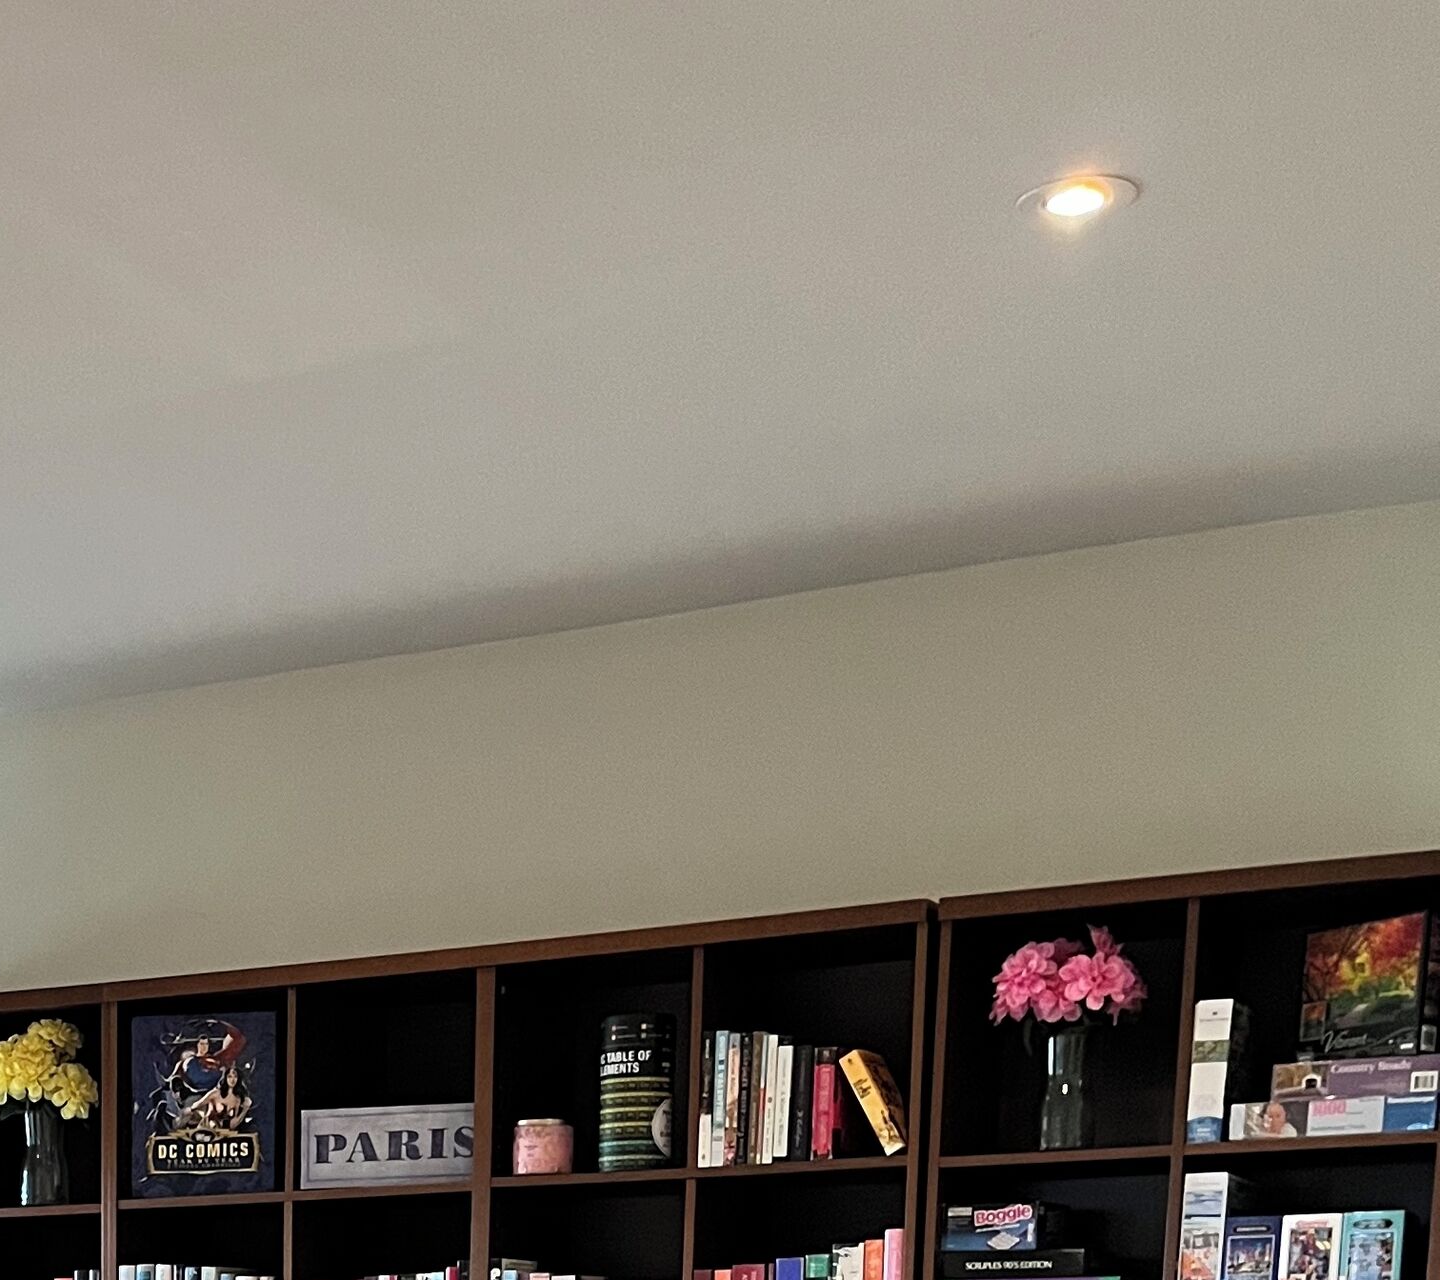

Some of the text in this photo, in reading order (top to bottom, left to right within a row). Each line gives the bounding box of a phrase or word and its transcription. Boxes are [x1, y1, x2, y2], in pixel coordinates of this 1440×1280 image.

[606, 1051, 635, 1063] TABLE
[638, 1050, 652, 1061] OF
[600, 1062, 640, 1077] LEMENTS
[158, 1141, 249, 1159] DC COMICS
[314, 1126, 474, 1164] PARIS
[974, 1204, 1033, 1226] Boggle
[1020, 1260, 1053, 1269] EDITION
